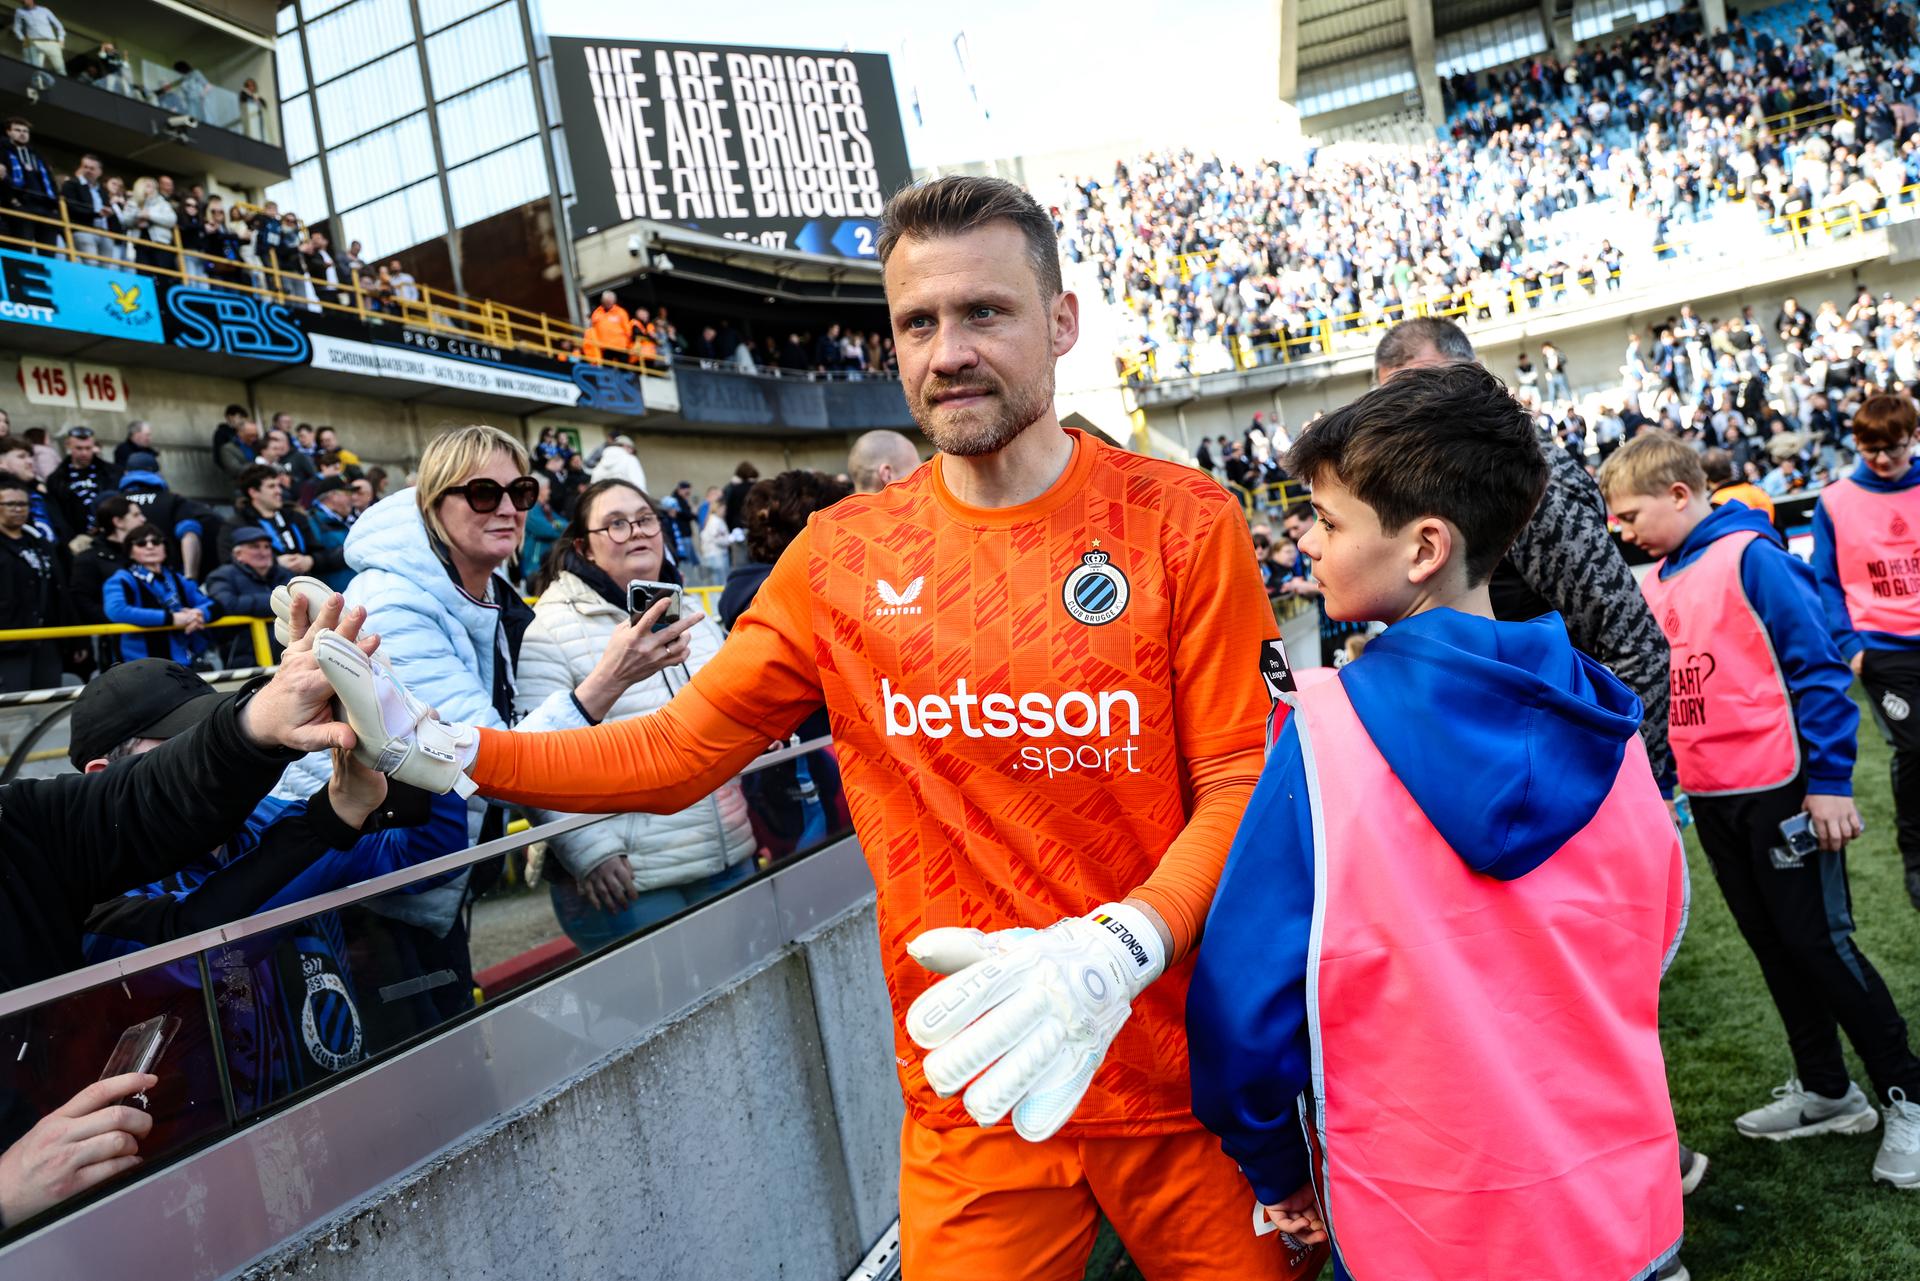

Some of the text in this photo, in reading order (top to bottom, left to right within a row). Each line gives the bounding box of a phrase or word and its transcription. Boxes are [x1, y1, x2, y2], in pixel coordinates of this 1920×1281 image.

[594, 97, 876, 171] WE ARE BRUGES
[854, 226, 875, 255] 2
[167, 284, 310, 363] SBS
[403, 330, 502, 361] PRO CLEAN
[32, 366, 67, 397] 115
[83, 372, 116, 402] 116
[1866, 559, 1887, 579] NO
[1872, 578, 1920, 598] NO GLO
[1067, 600, 1084, 618] CLUB
[1084, 609, 1116, 622] BRUGGE
[1268, 670, 1287, 681] League
[1269, 659, 1279, 669] Pro
[881, 678, 1140, 739] betsson
[1012, 738, 1141, 779] .sport
[1105, 920, 1150, 968] MIGNOLET
[922, 964, 1003, 1029] ELITE
